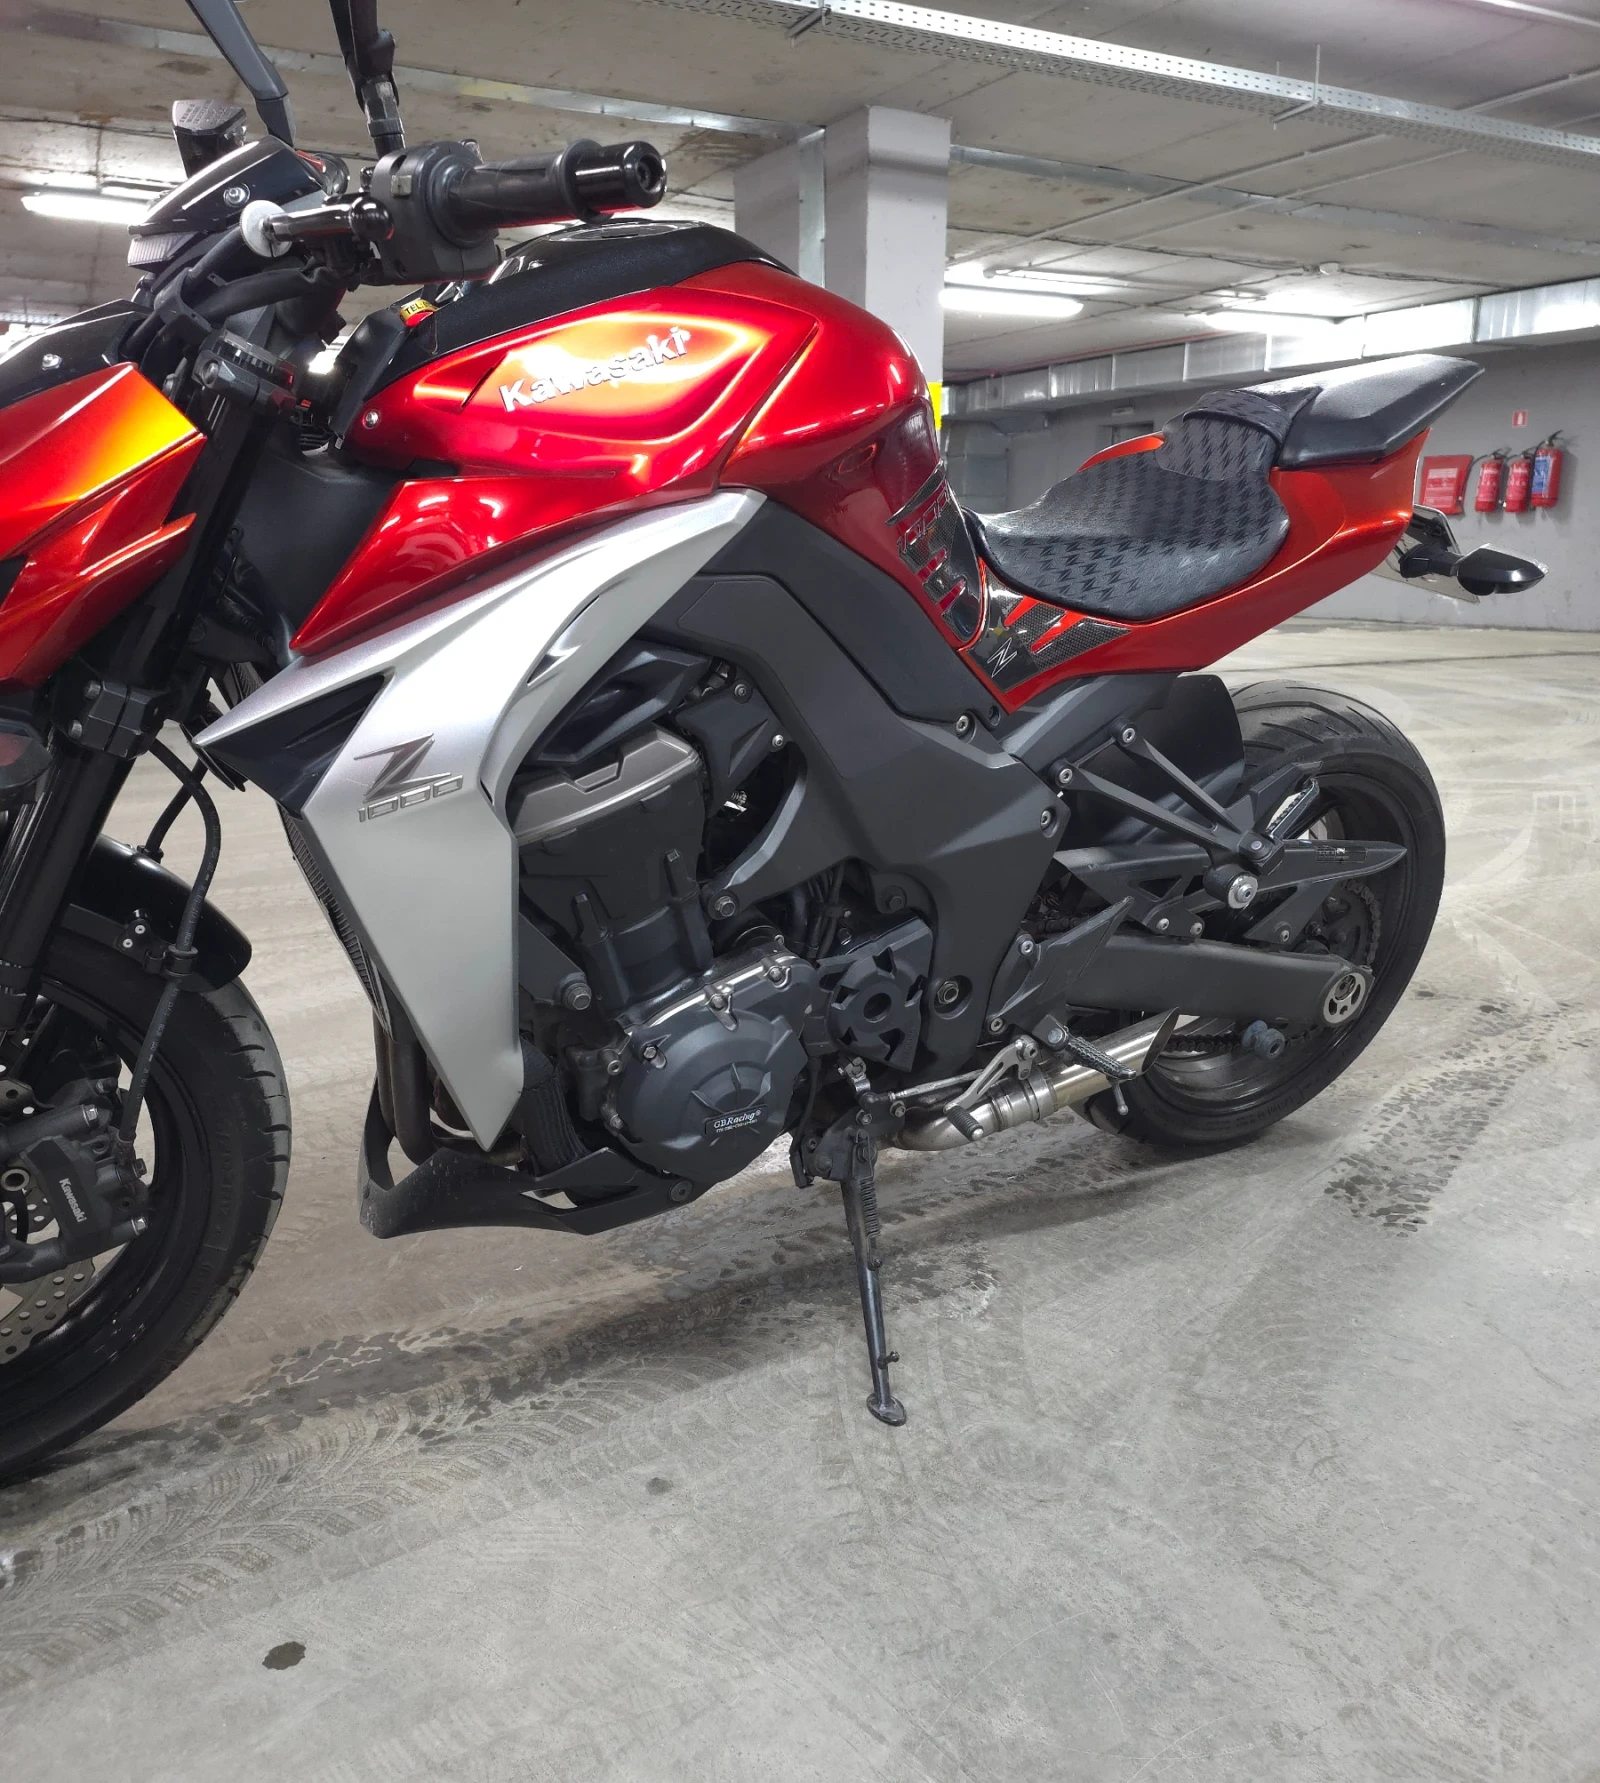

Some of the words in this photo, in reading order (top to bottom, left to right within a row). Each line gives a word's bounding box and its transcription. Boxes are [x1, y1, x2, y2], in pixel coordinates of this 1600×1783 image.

[498, 326, 688, 412] Kawasaki
[357, 774, 464, 823] 1000
[59, 1178, 87, 1223] Kawasaki
